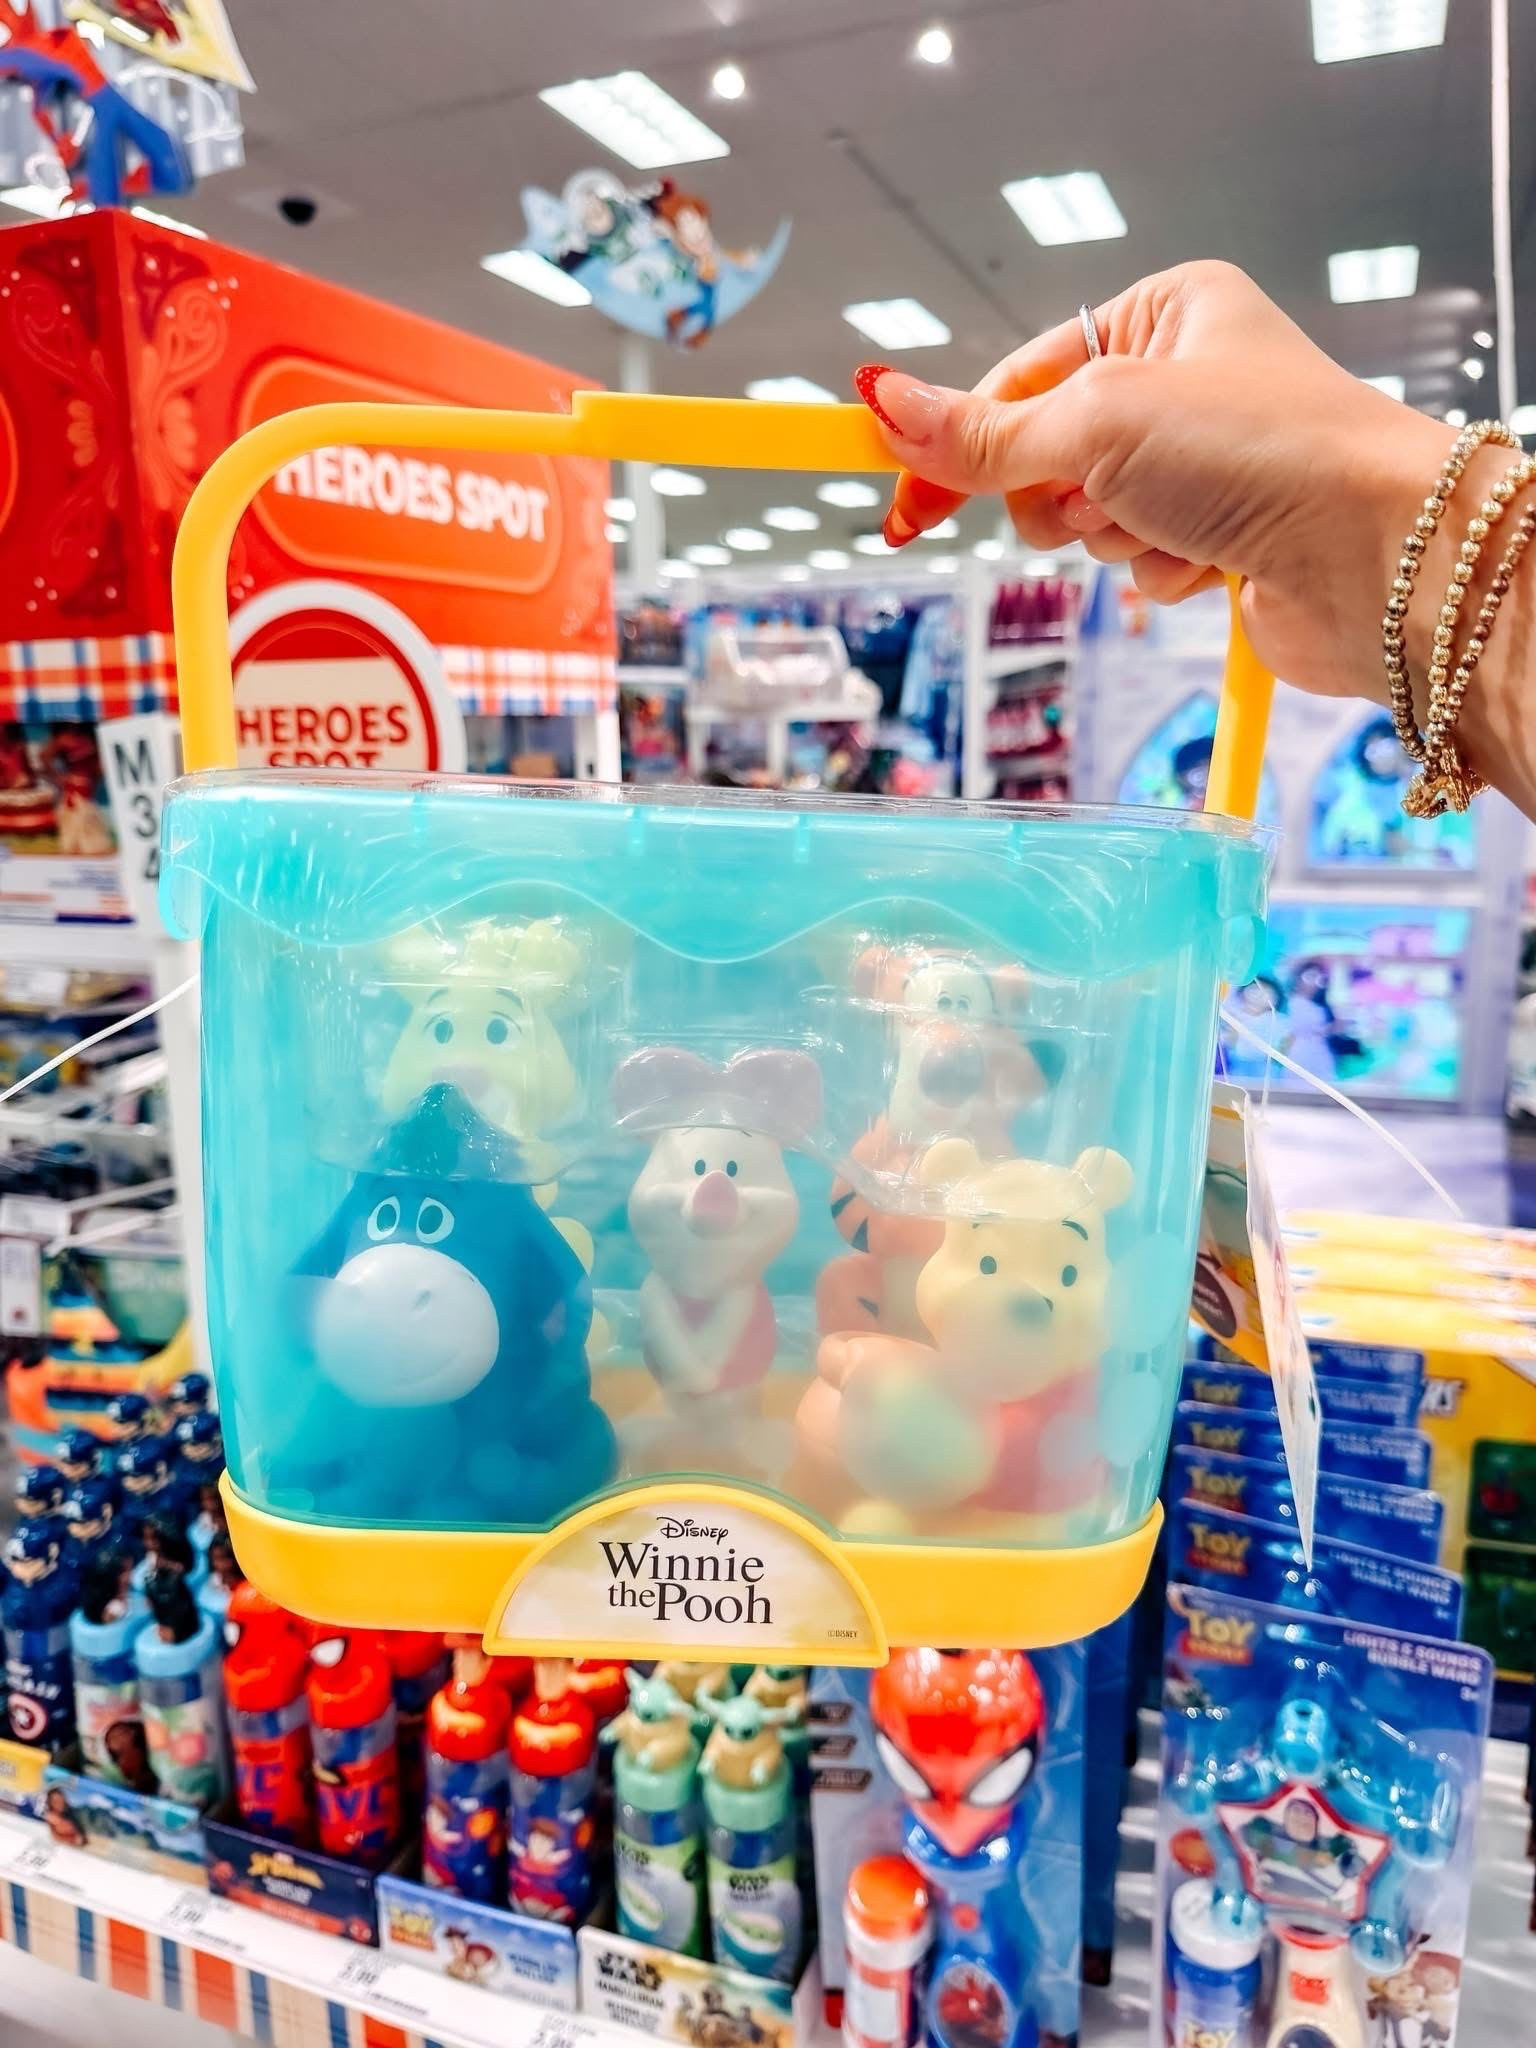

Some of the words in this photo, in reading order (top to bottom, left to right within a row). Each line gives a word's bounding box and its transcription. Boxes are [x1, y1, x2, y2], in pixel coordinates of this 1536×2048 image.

[275, 444, 454, 525] HEROES
[456, 468, 549, 542] SPOT
[236, 705, 410, 746] HEROES
[113, 739, 156, 787] M
[130, 794, 158, 838] 3
[656, 1516, 729, 1546] Disney
[1187, 1521, 1250, 1556] TOY
[598, 1541, 765, 1583] Winnie
[607, 1580, 656, 1608] the
[652, 1581, 774, 1624] Pooh
[1185, 1605, 1256, 1646] TOY
[1343, 1628, 1399, 1653] LIGHTS
[1414, 1644, 1483, 1672] SOUNDS
[1367, 1649, 1428, 1676] BUBBLE
[1430, 1661, 1480, 1686] WAND
